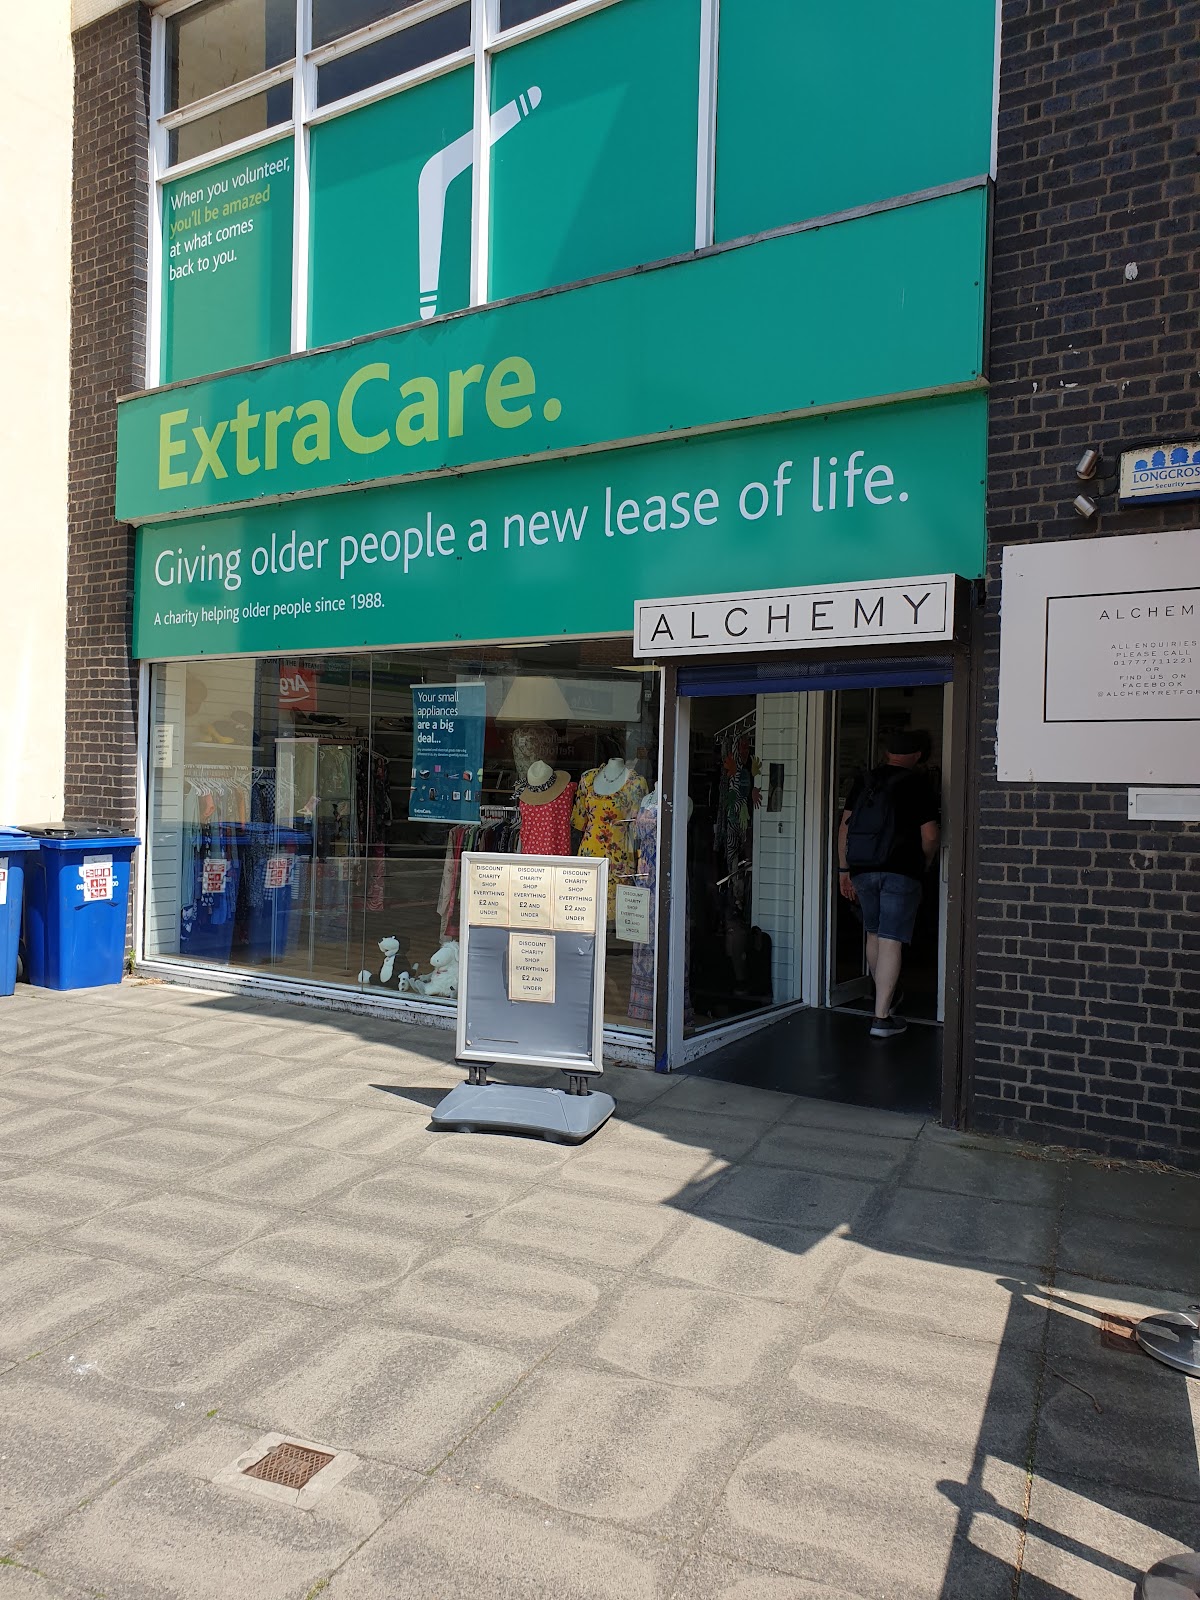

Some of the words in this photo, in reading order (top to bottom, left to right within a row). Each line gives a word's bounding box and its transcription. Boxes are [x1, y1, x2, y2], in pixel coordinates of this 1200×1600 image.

[170, 188, 204, 211] When
[206, 179, 229, 203] you
[231, 156, 291, 189] volunteer,
[169, 208, 202, 240] you'll
[204, 206, 220, 223] be
[222, 183, 271, 217] amazed
[169, 240, 182, 258] at
[183, 230, 213, 253] what
[215, 218, 254, 243] comes
[169, 258, 195, 281] back
[197, 257, 210, 272] to
[212, 249, 238, 273] you.
[158, 356, 563, 490] ExtraCare.
[1133, 467, 1200, 483] LONGCROS
[1155, 481, 1185, 489] Security
[154, 544, 242, 591] Giving
[251, 529, 330, 576] older
[340, 511, 456, 580] people
[467, 517, 488, 553] a
[503, 505, 589, 549] new
[604, 486, 720, 538] lease
[738, 460, 794, 521] of
[811, 450, 910, 513] life.
[153, 612, 162, 626] A
[164, 609, 199, 627] charity
[201, 605, 240, 624] helping
[242, 602, 271, 618] older
[273, 597, 312, 620] people
[314, 596, 346, 613] since
[350, 592, 385, 611] 1988.
[1099, 604, 1194, 621] ALCHEM
[650, 592, 932, 643] ALCHEMY
[1135, 640, 1197, 649] ENQUIRIES
[417, 691, 436, 703] Your
[437, 690, 460, 703] small
[417, 705, 459, 719] appliances
[417, 721, 431, 730] are
[432, 722, 438, 730] a
[440, 719, 454, 733] big
[417, 732, 442, 744] deal...
[564, 904, 574, 912] £2
[565, 914, 585, 922] UNDER
[518, 940, 547, 948] DISCOUNT
[520, 948, 544, 956] CHARITY
[515, 965, 549, 973] EVERYTHING
